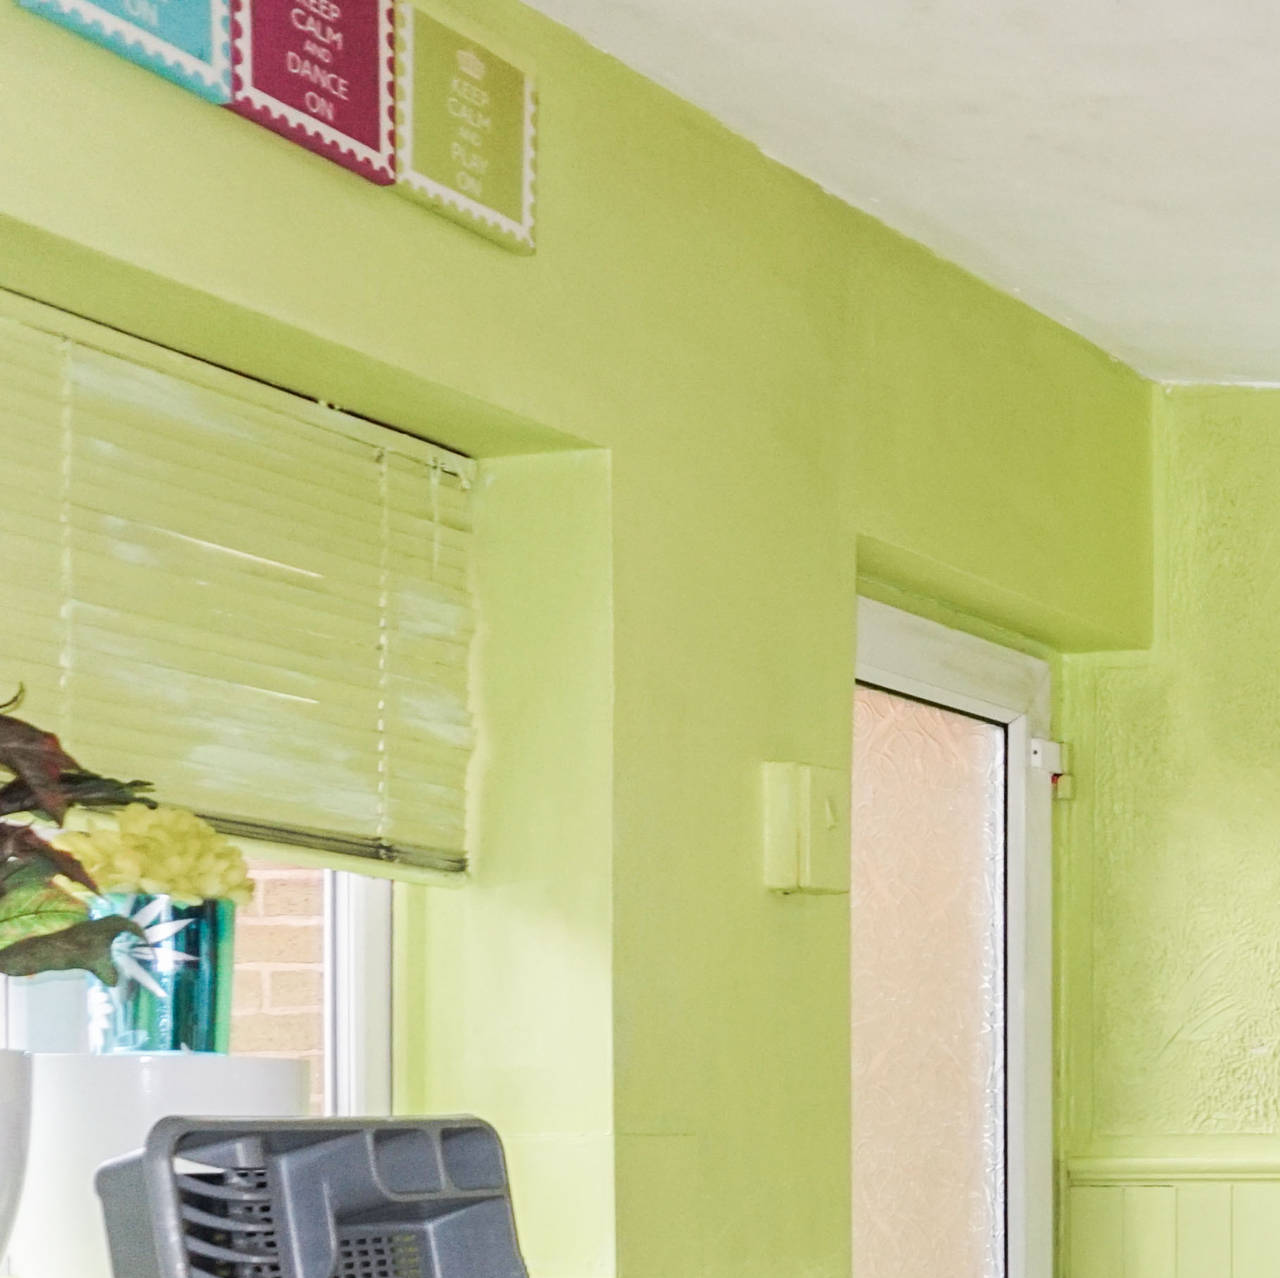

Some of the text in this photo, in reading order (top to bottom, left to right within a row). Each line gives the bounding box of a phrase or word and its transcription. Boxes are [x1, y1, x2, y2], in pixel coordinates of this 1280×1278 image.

[297, 0, 342, 21] EEP
[291, 8, 344, 50] CALM
[286, 51, 350, 101] DANCE
[304, 91, 335, 121] ON
